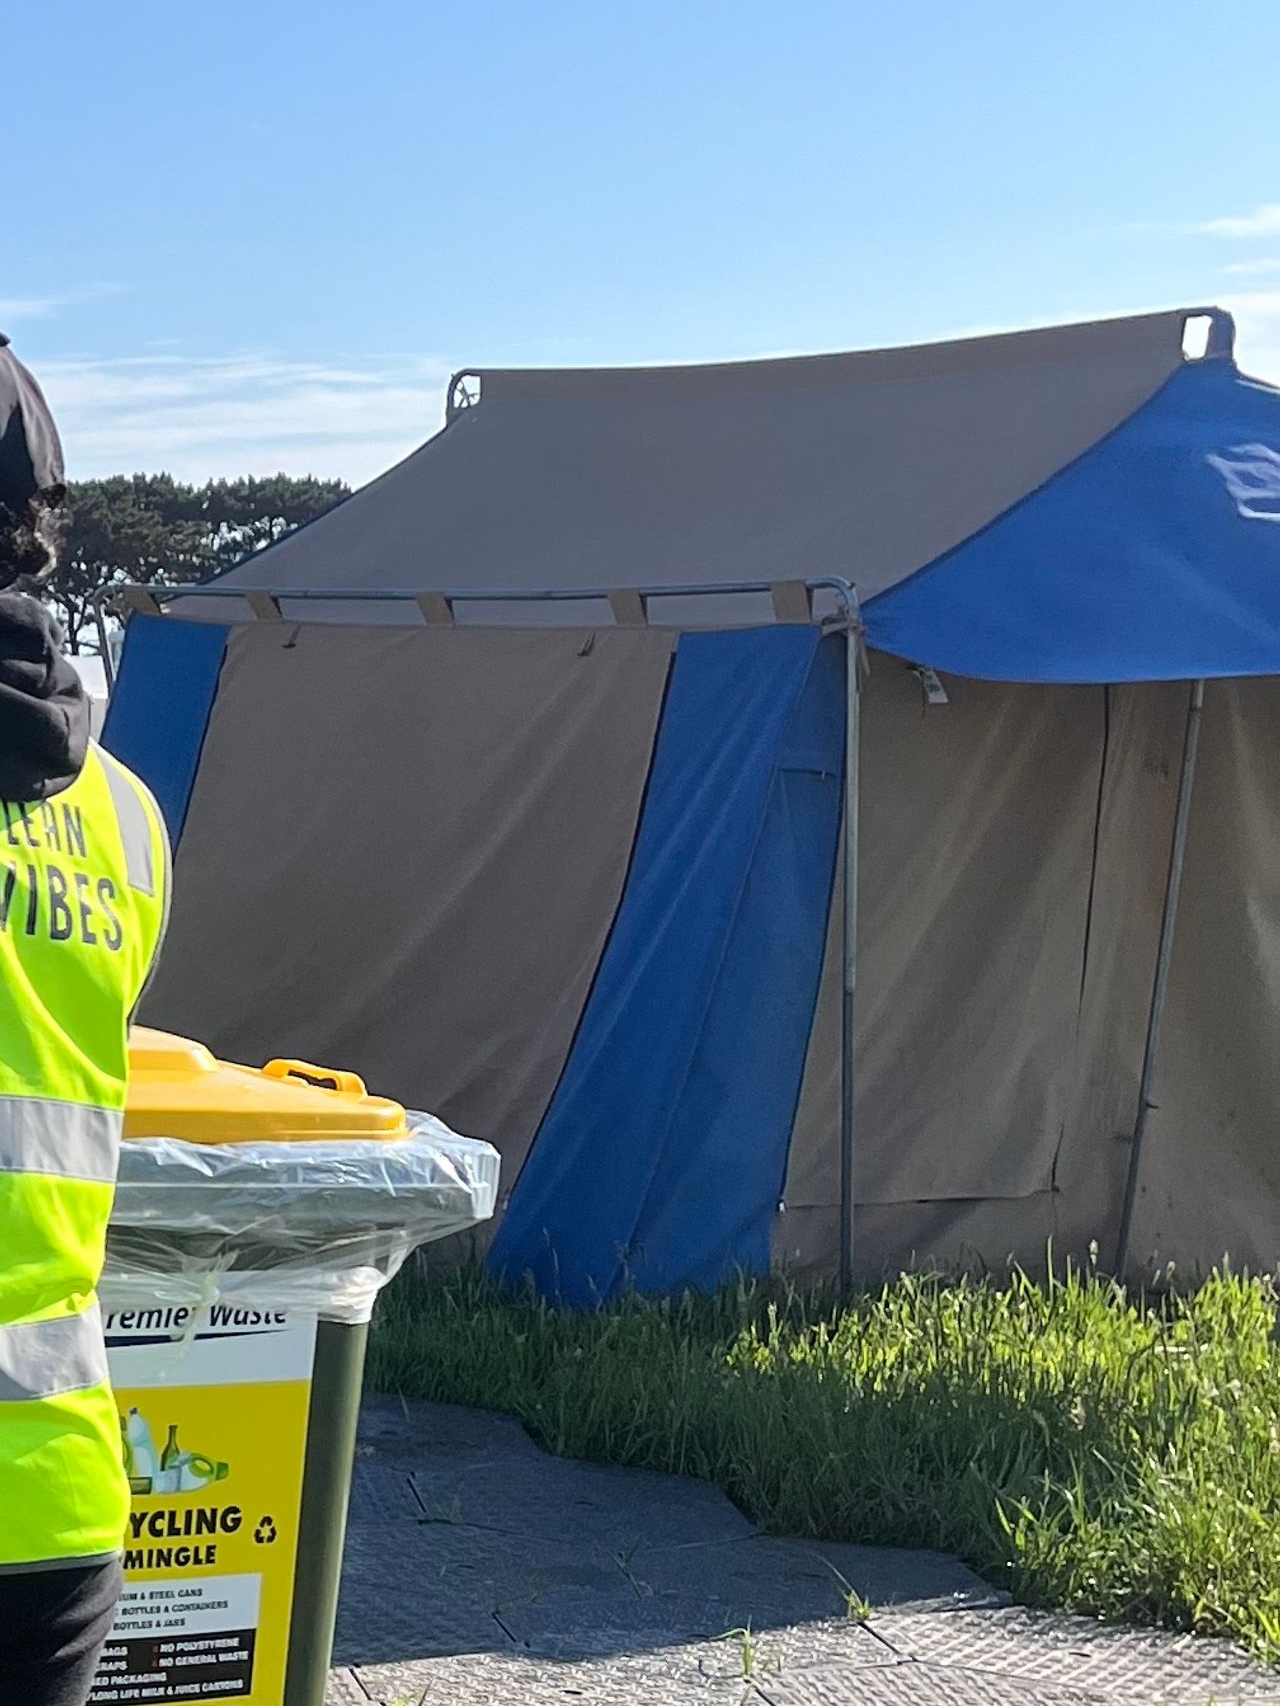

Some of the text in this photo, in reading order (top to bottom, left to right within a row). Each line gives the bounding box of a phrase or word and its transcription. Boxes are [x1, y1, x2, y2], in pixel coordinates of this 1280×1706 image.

[130, 1505, 243, 1539] YCLING
[123, 1545, 217, 1570] MINGLE
[122, 1605, 160, 1616] BOTTLES
